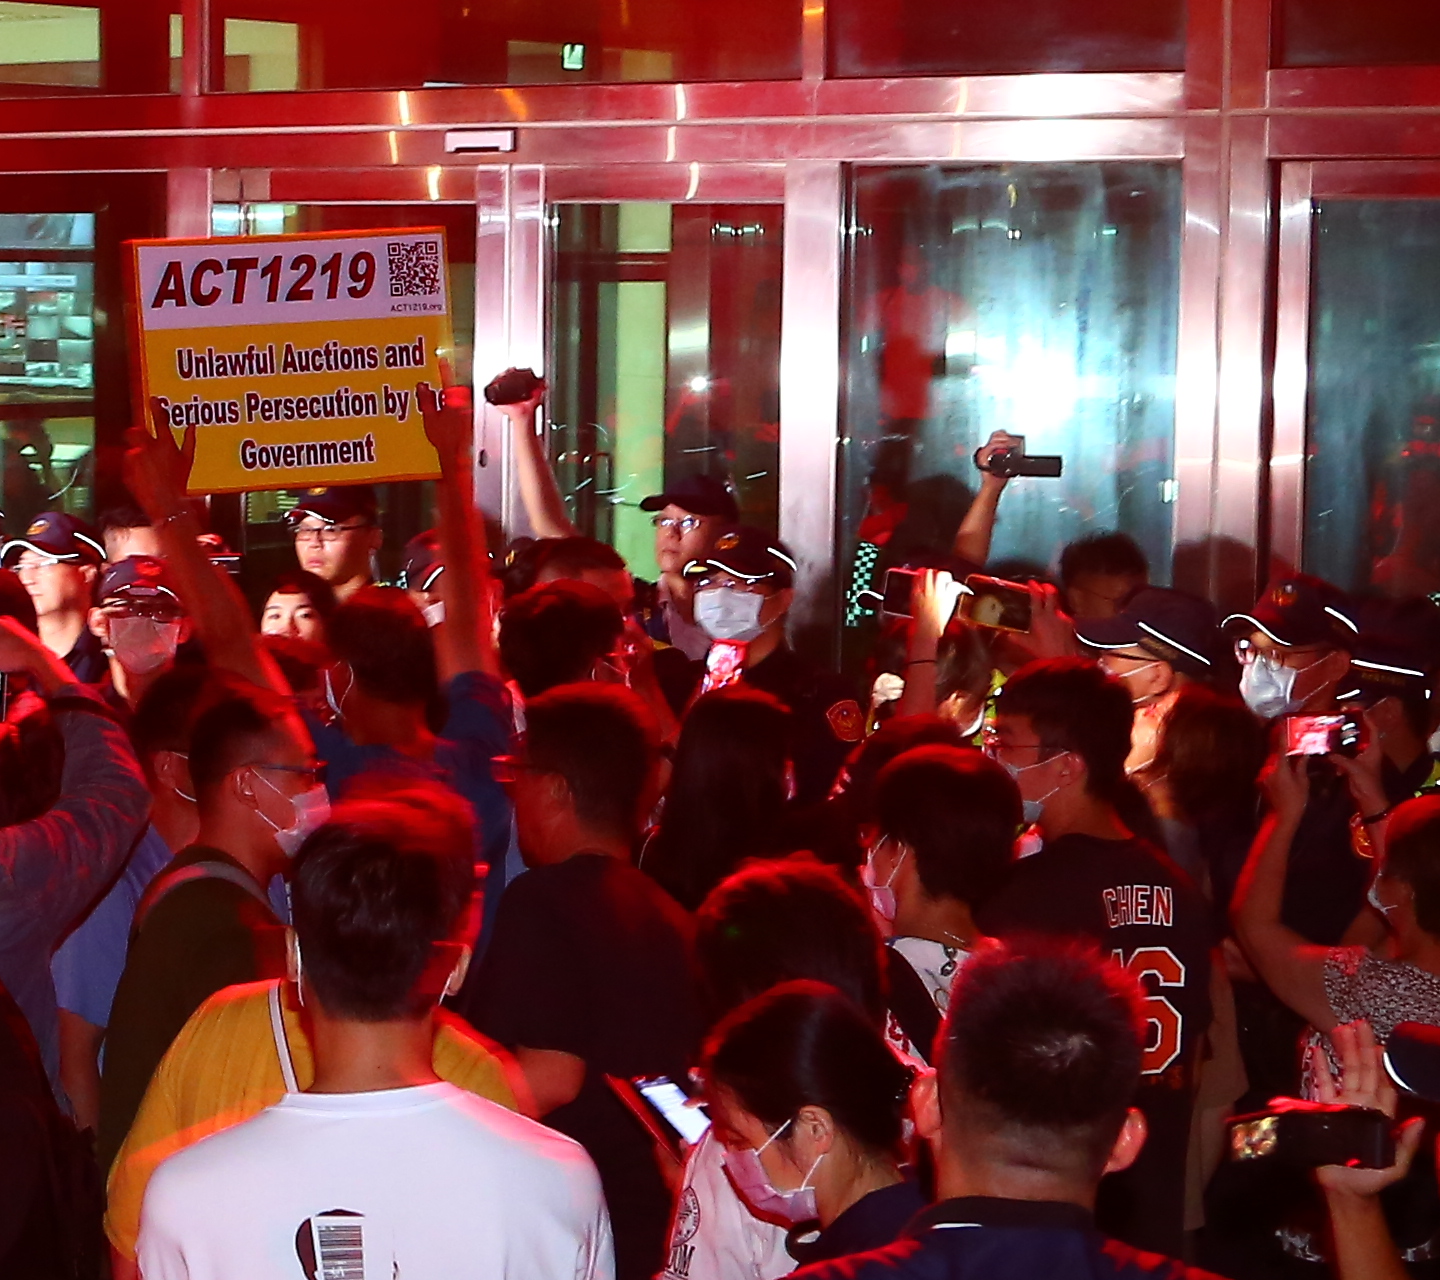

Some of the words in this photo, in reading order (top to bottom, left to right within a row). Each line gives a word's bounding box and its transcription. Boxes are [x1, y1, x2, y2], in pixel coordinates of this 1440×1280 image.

[151, 250, 377, 310] ACT1219
[176, 345, 275, 381] Unlawful
[282, 340, 378, 375] Auctions
[386, 336, 425, 368] and
[245, 387, 378, 423] Persecution
[383, 385, 409, 421] by
[240, 433, 376, 471] Government
[1102, 885, 1173, 928] CHEN
